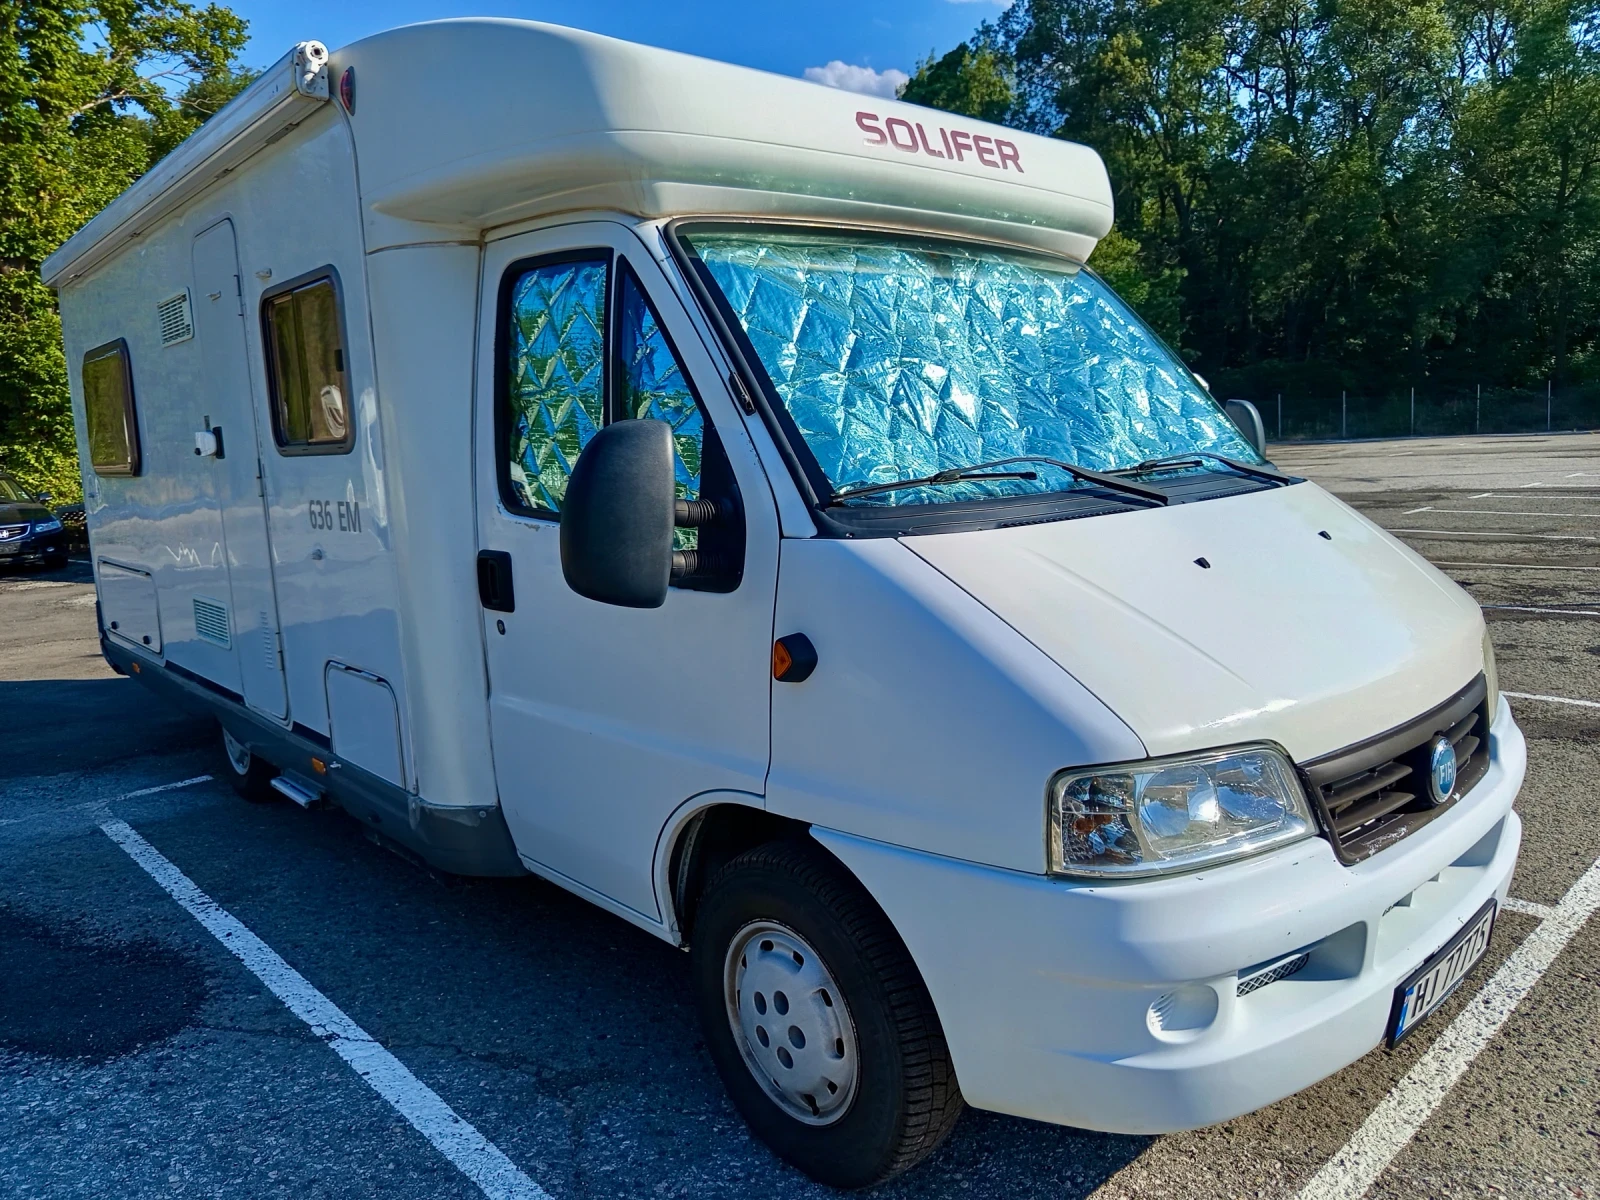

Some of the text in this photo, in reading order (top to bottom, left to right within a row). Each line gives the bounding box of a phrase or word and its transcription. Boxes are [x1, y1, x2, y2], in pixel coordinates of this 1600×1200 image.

[855, 111, 1025, 174] SOLIFER
[309, 499, 362, 533] 636 EM
[1410, 967, 1440, 1019] HJ
[1441, 916, 1489, 991] 77775
